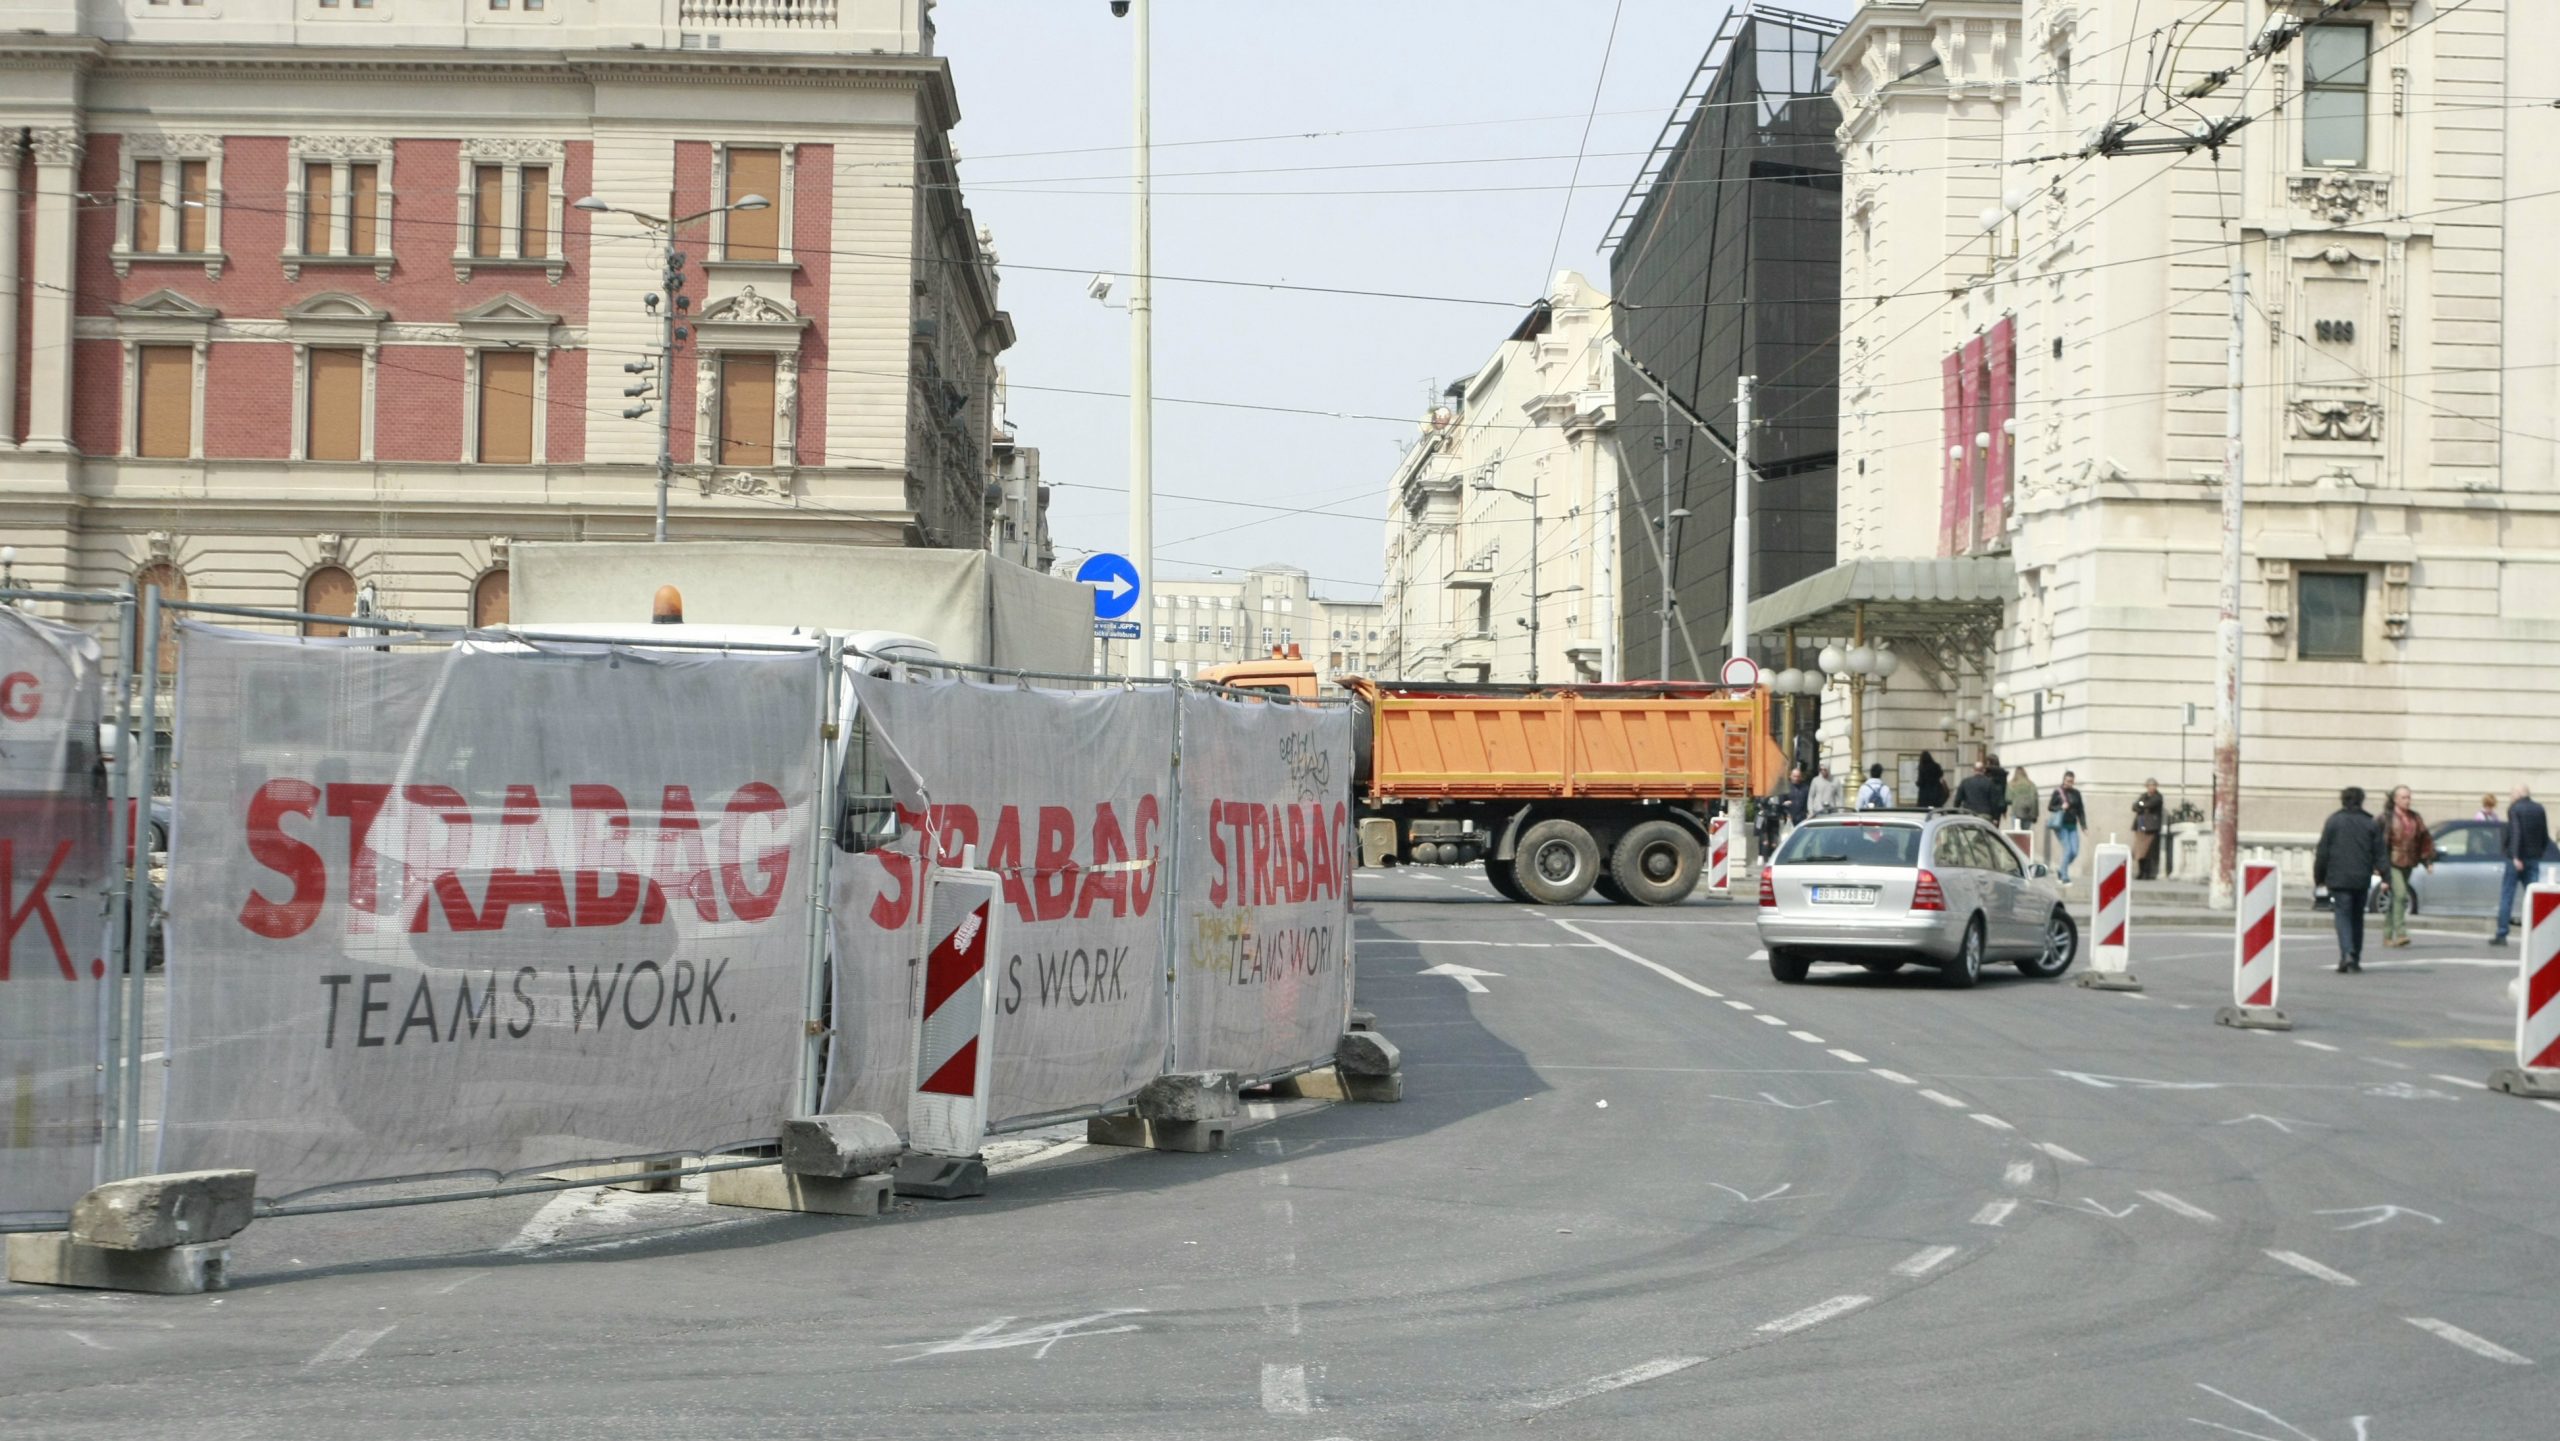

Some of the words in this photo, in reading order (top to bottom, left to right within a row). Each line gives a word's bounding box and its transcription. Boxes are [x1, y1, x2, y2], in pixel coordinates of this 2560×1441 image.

[238, 778, 790, 940] STRABAG
[1209, 798, 1347, 909] STRABAG
[319, 965, 537, 1049] TEAMS
[569, 956, 738, 1033] WORK.
[1037, 946, 1128, 1010] WORK.
[1227, 931, 1285, 986] TEAMS
